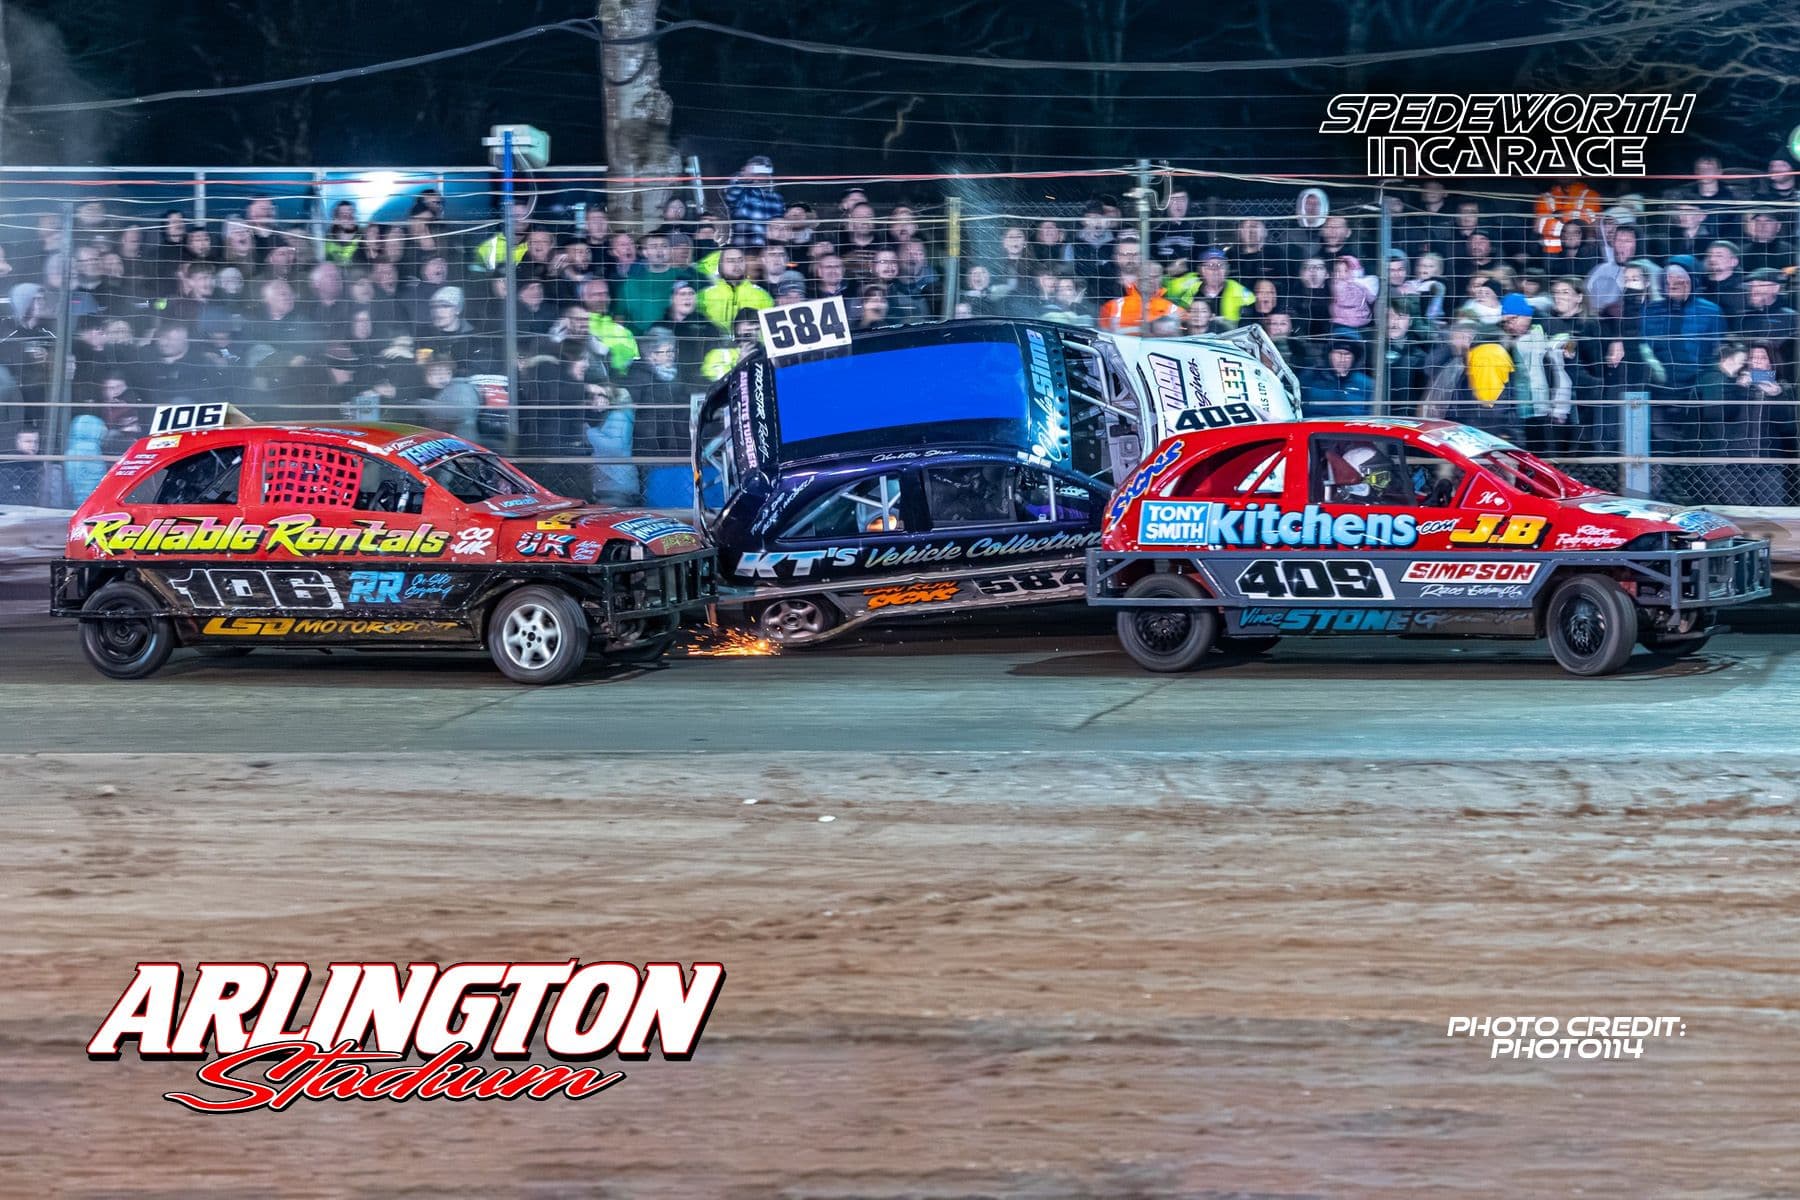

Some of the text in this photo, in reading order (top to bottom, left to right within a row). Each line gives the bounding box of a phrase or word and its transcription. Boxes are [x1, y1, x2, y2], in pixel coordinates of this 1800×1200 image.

[766, 301, 847, 348] 584
[1217, 356, 1249, 402] LEET
[158, 404, 223, 432] 106
[1175, 403, 1258, 430] 409
[1149, 505, 1206, 524] TONY
[1209, 502, 1418, 546] kitchens
[1449, 513, 1547, 546] J.B
[84, 512, 449, 557] Reliable Rentals
[1145, 522, 1204, 541] SMITH
[734, 530, 1102, 578] KT'S Vehicle Collection
[348, 571, 405, 603] RR
[975, 569, 1088, 596] 584
[1236, 560, 1385, 600] 409
[1408, 563, 1535, 580] SIMPSON
[168, 568, 344, 610] 106
[202, 617, 294, 636] LSD
[1239, 607, 1282, 626] Vince
[1279, 609, 1412, 631] STONE
